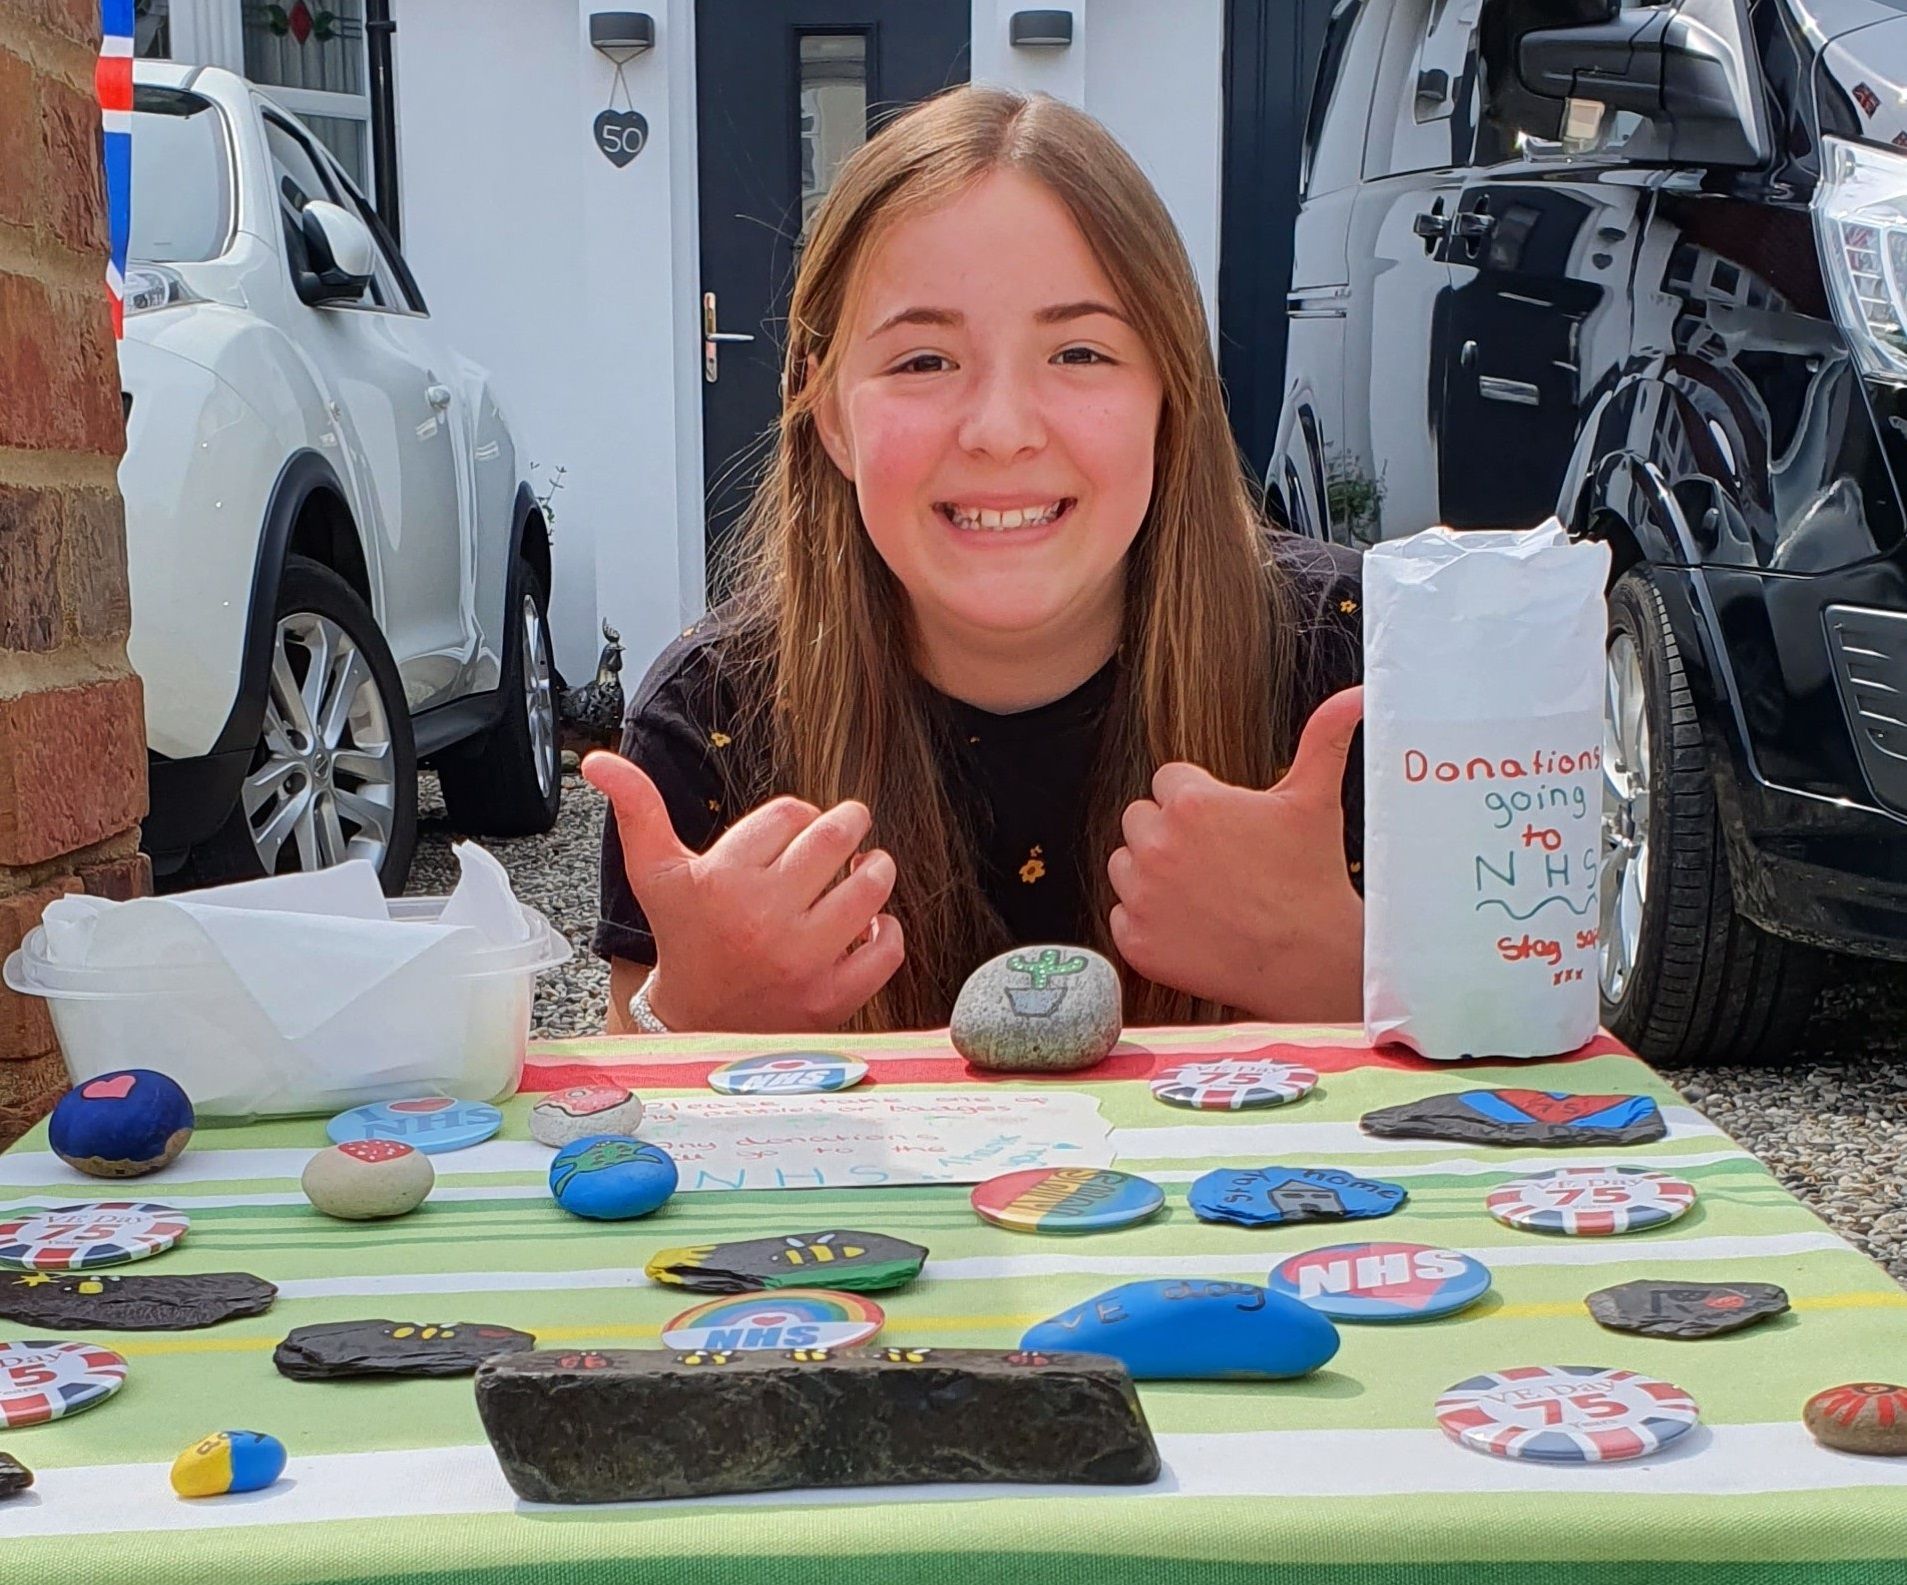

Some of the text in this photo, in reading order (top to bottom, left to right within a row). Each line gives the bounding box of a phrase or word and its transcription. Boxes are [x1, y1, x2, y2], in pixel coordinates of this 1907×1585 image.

[602, 125, 644, 153] 50
[1404, 747, 1599, 782] Donations
[1484, 784, 1586, 829] going
[1521, 823, 1562, 851] to
[1475, 848, 1598, 891] NHS
[743, 1070, 830, 1089] NHS
[1197, 1072, 1262, 1085] 75
[363, 1107, 499, 1138] NHS
[695, 1165, 889, 1190] NHS
[1545, 1186, 1632, 1206] 75
[38, 1223, 118, 1241] 75
[1298, 1250, 1467, 1300] NHS
[704, 1325, 820, 1351] NHS
[1482, 1380, 1617, 1404] VE Day
[1512, 1393, 1629, 1426] 75
